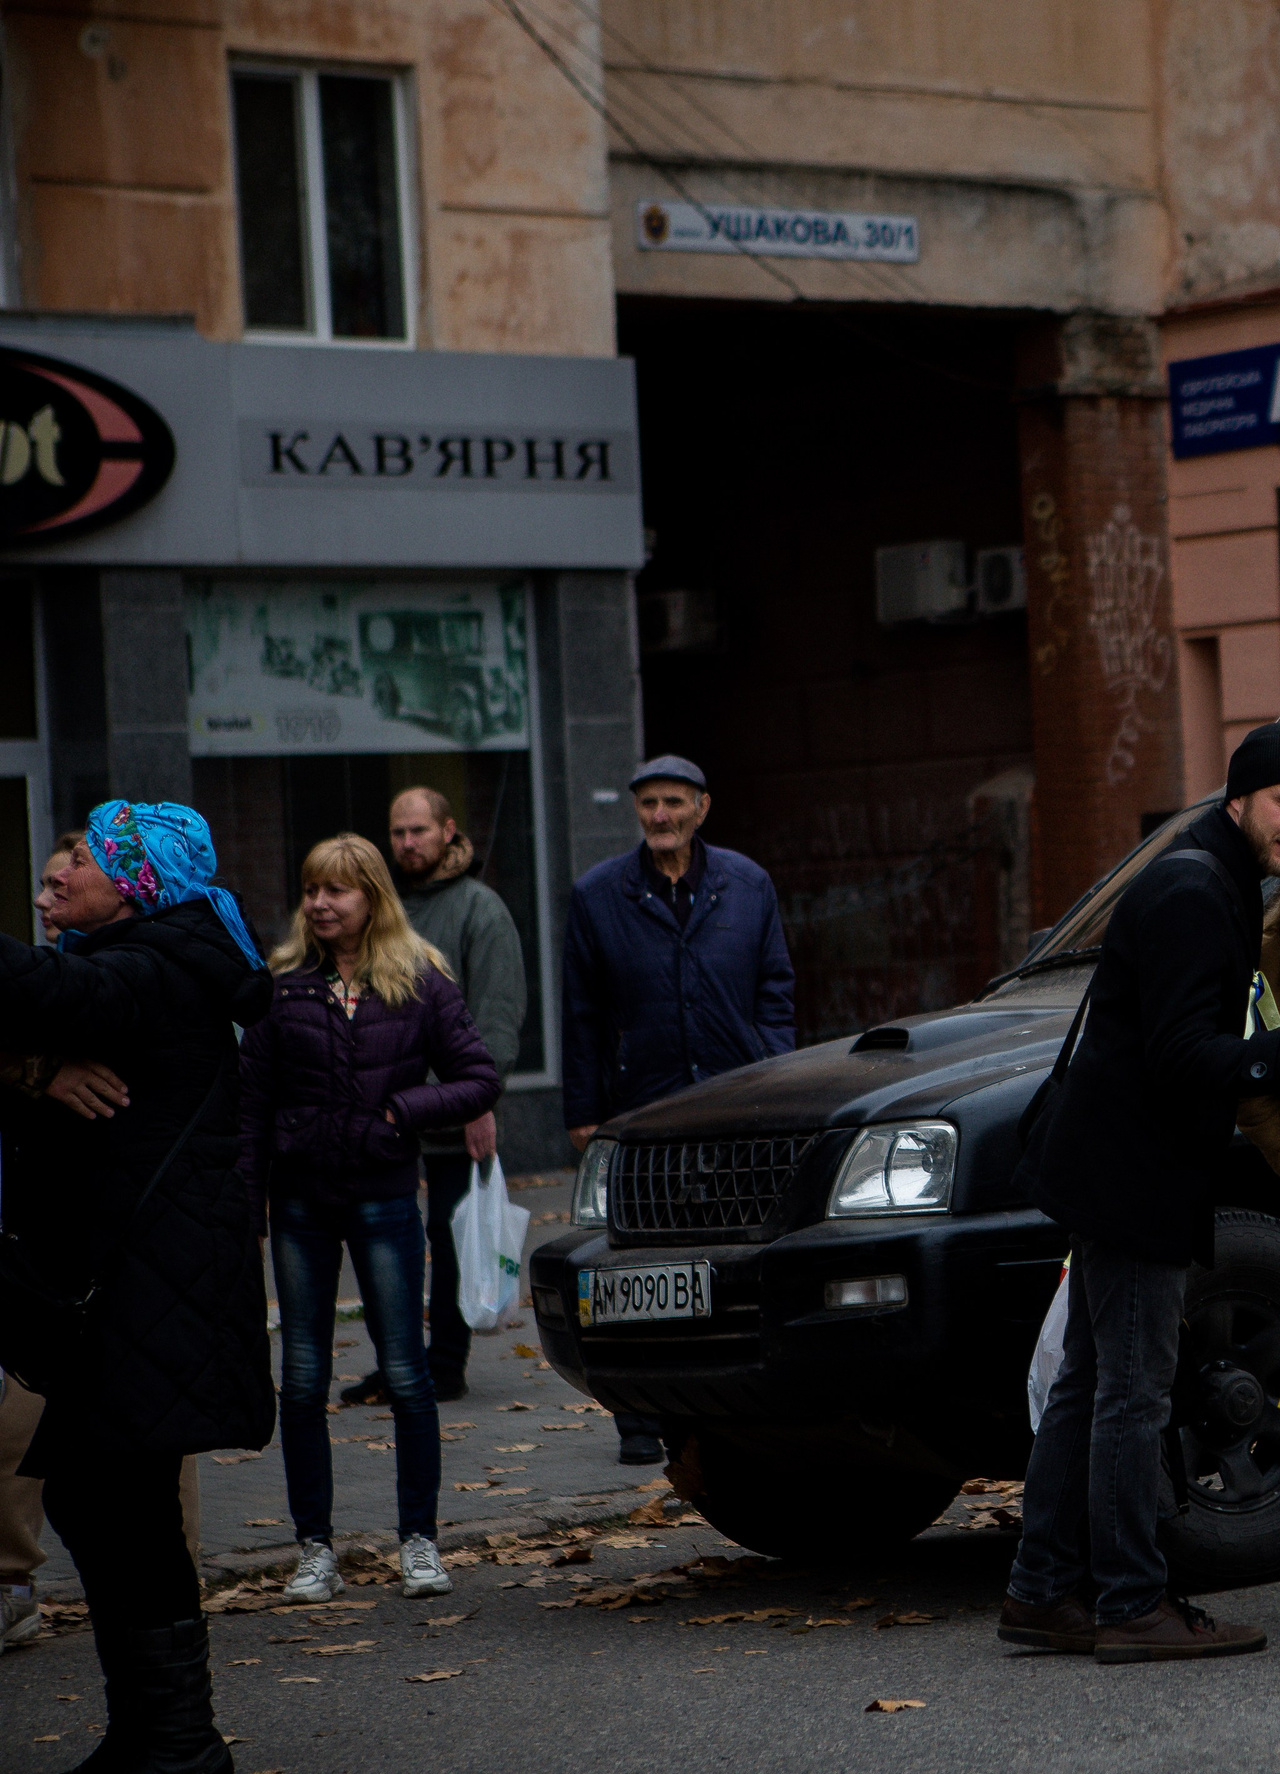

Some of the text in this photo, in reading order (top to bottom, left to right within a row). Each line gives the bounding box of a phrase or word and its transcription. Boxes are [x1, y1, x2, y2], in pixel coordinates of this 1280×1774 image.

[864, 221, 914, 250] 30/1
[592, 1271, 705, 1315] AM 9090 BA
